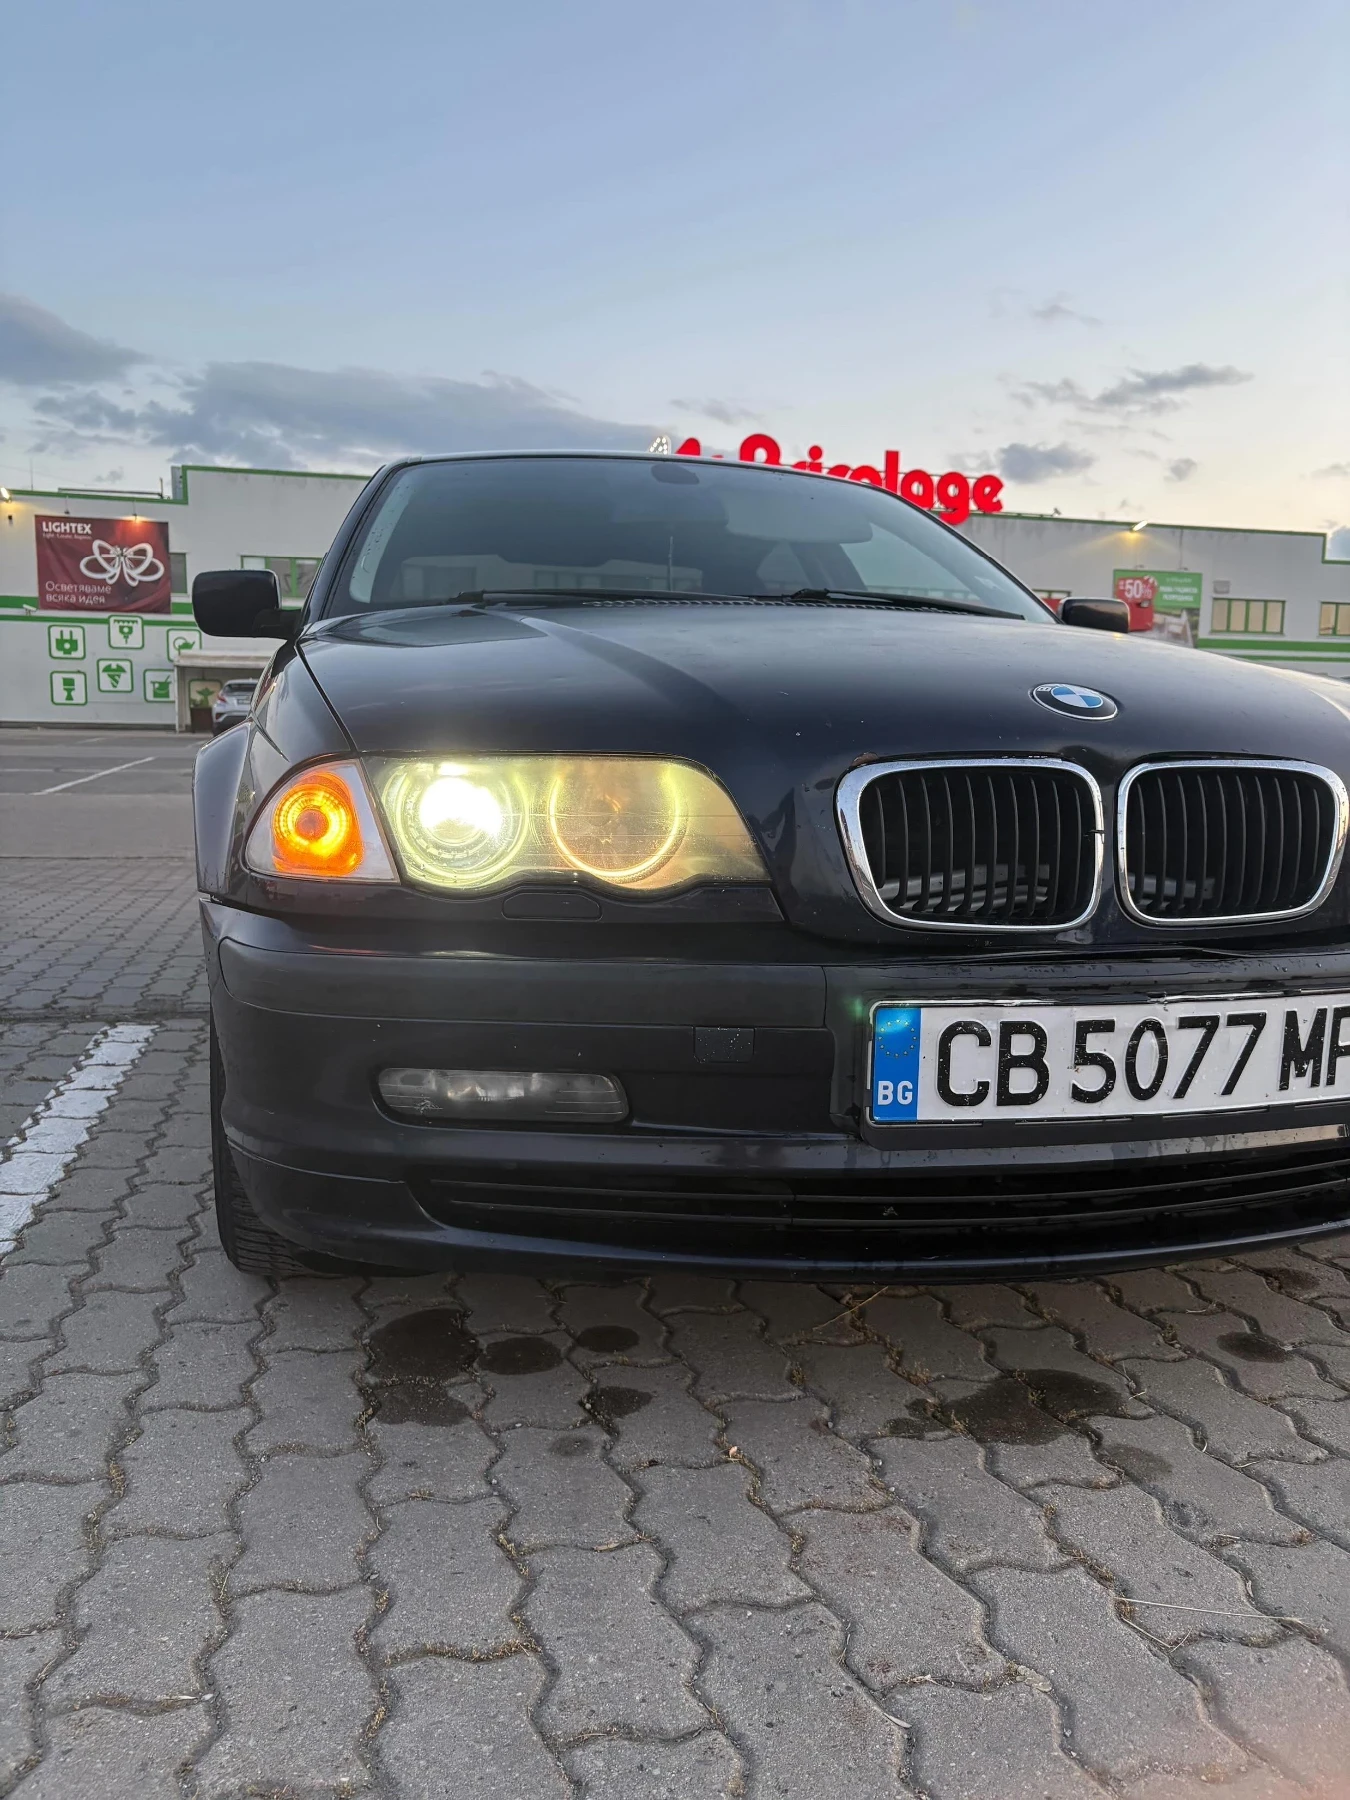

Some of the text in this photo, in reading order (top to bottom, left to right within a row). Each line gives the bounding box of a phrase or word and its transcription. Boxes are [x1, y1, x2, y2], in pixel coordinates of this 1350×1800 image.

[738, 433, 1004, 525] iolage
[42, 521, 92, 534] LIGHTEX
[45, 581, 112, 594] Осветяваме
[46, 593, 106, 605] всяка идея
[1070, 1011, 1268, 1103] 5077
[876, 1080, 914, 1106] BG
